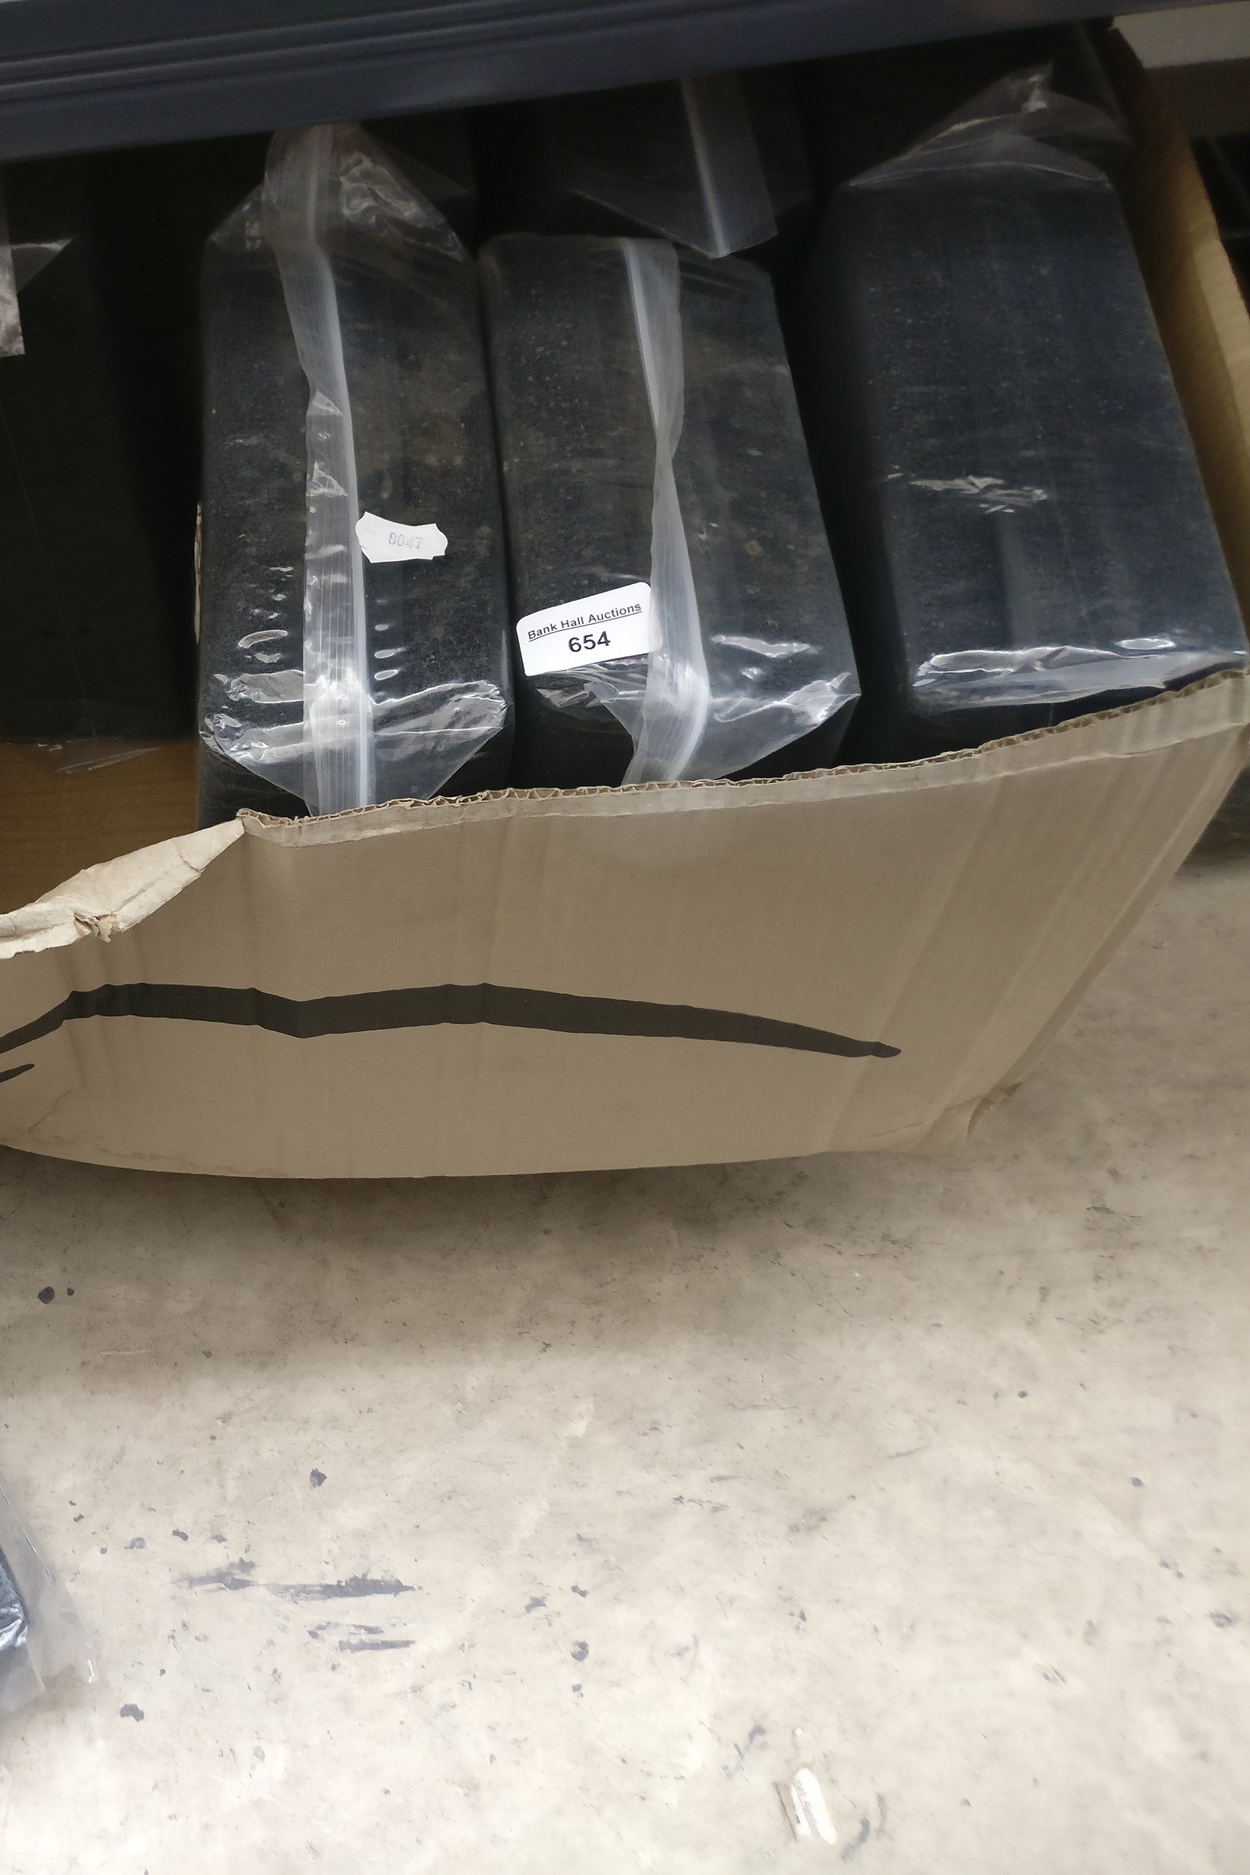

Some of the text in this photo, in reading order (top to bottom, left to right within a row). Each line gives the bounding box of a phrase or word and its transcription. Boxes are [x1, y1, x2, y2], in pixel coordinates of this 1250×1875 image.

[527, 603, 642, 640] Bank Hall Auctions
[568, 631, 611, 653] 654
